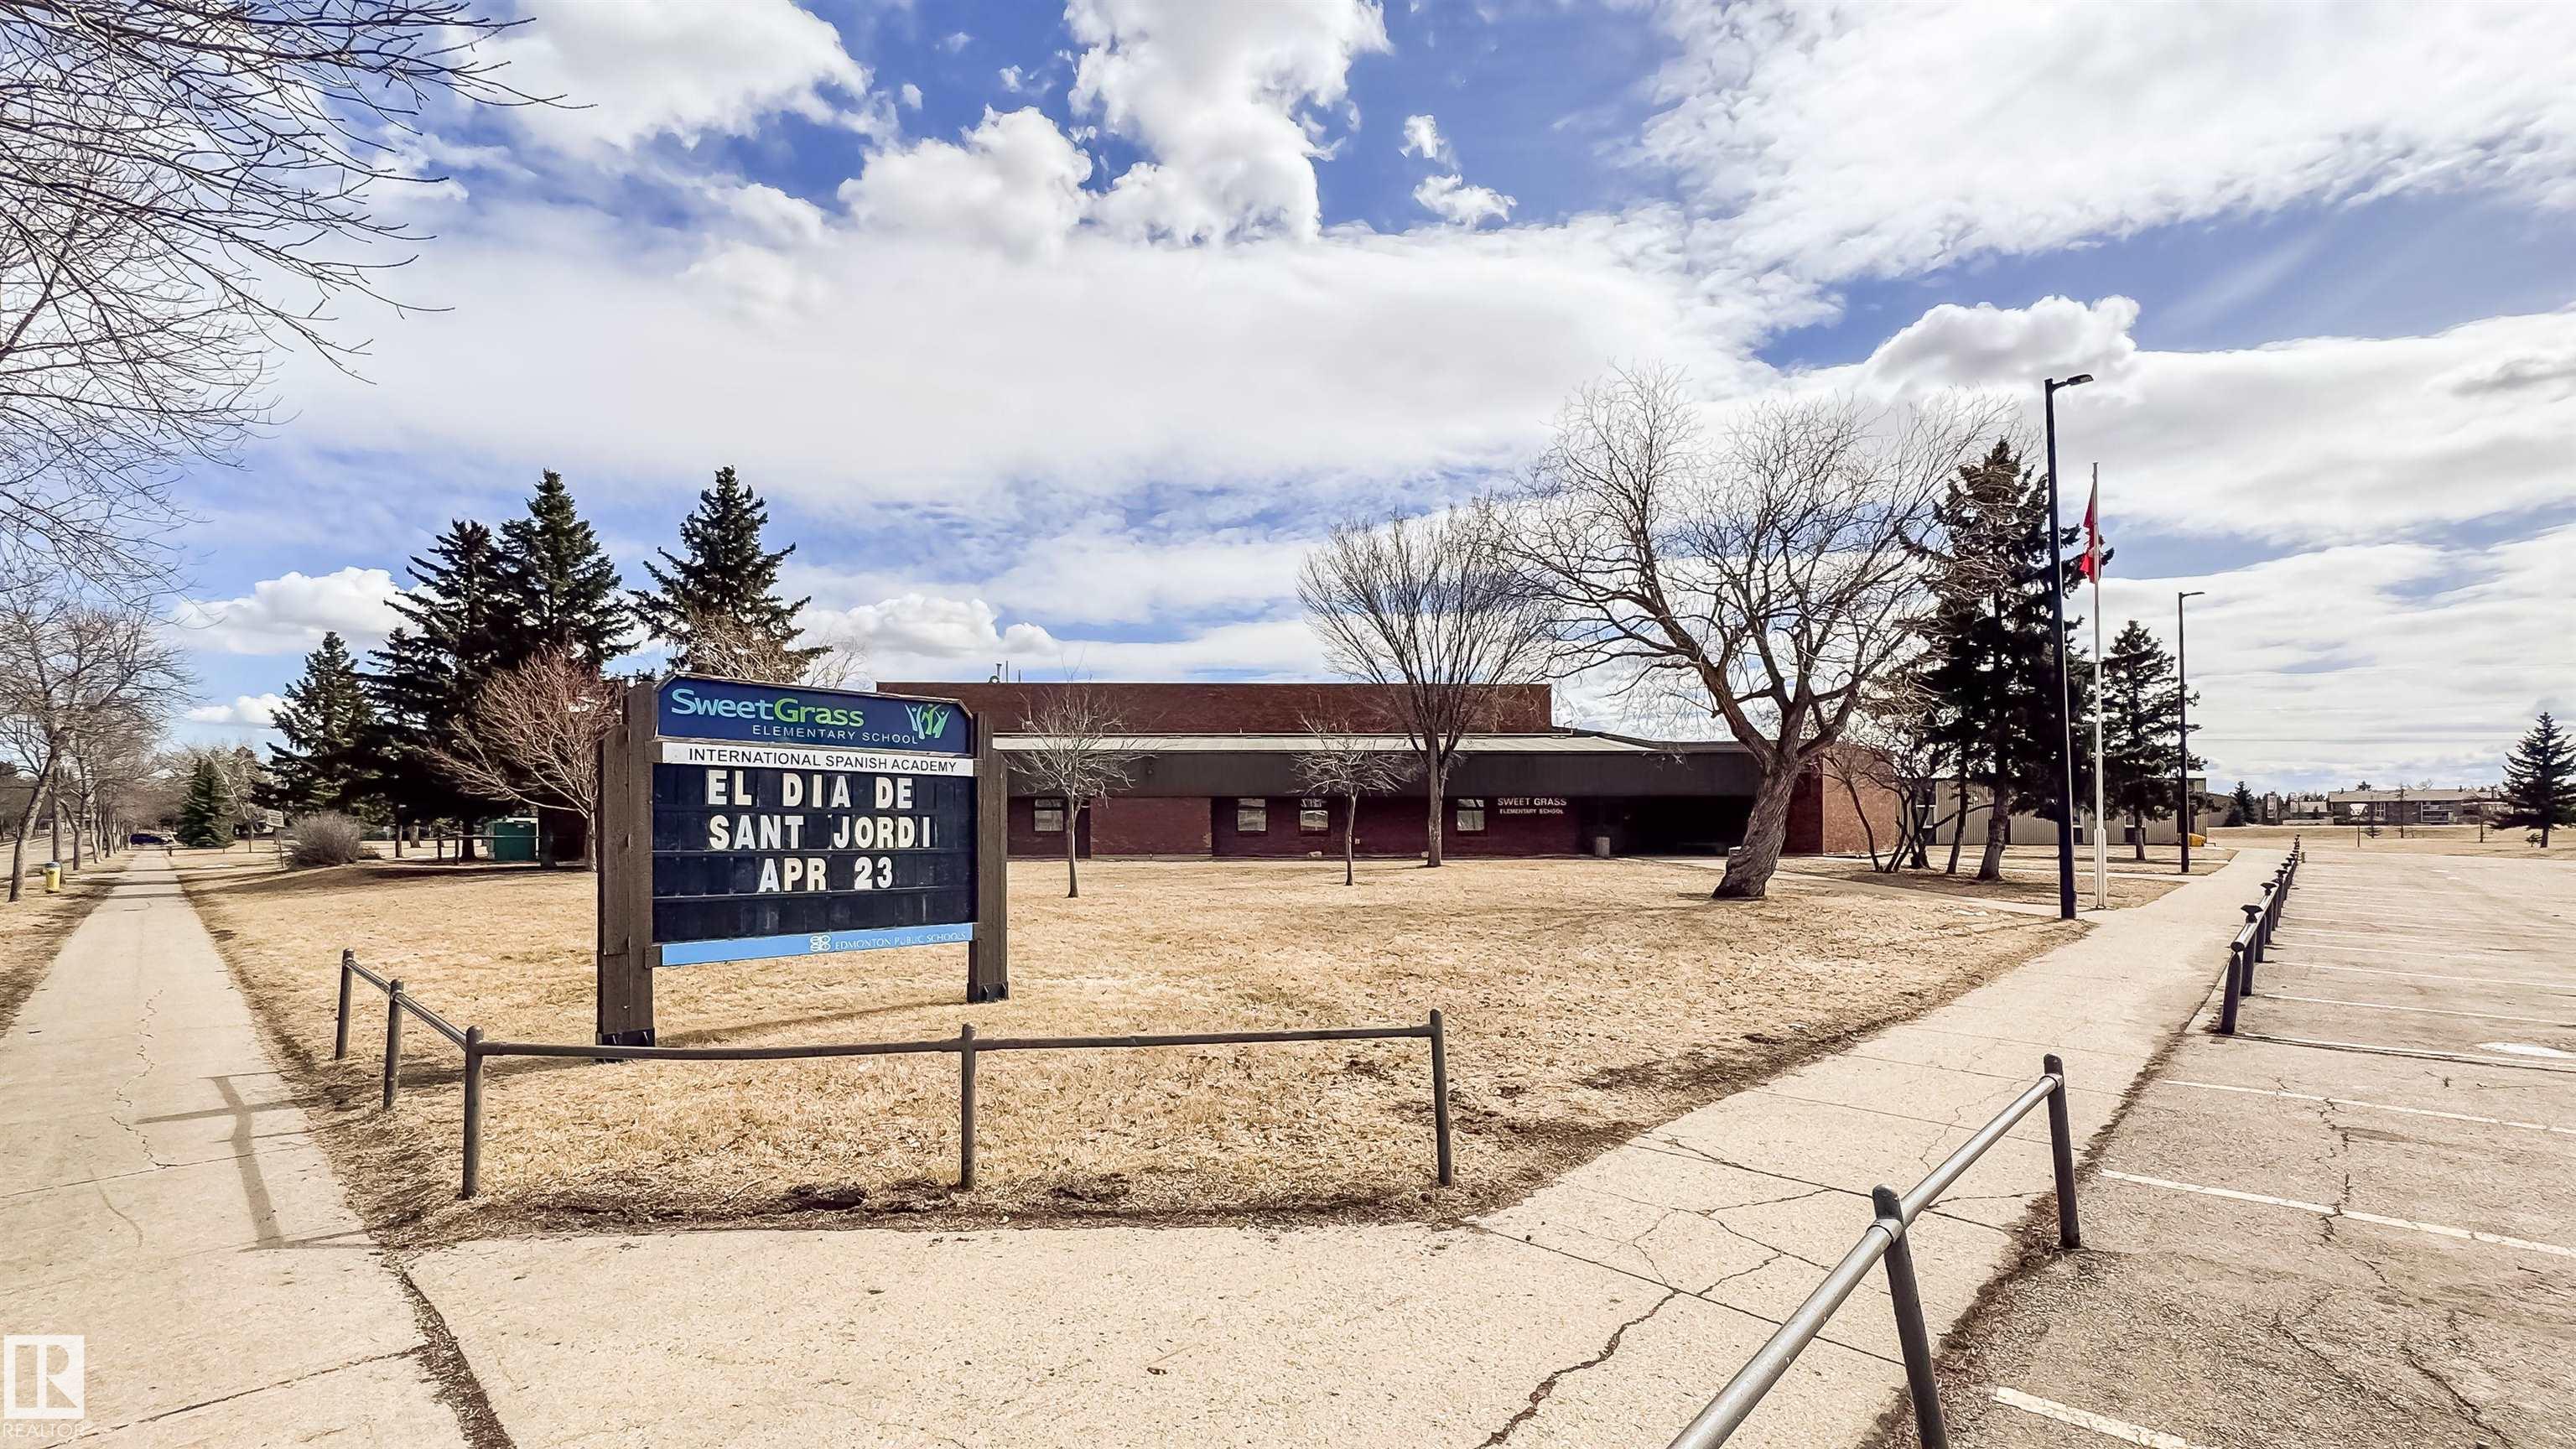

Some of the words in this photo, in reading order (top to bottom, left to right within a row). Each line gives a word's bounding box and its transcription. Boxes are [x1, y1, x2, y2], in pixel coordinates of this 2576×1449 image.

[753, 724, 855, 741] ELEMENTARY
[862, 732, 918, 745] SCHOOL
[688, 748, 821, 767] INTERNATIONAL
[825, 755, 887, 770] SPANISH
[891, 759, 957, 772] ACADEMY
[707, 769, 752, 806] EL
[782, 772, 851, 808] DIA
[875, 776, 913, 809] DE
[1497, 797, 1531, 806] SWEET
[1534, 797, 1567, 806] GRASS
[709, 814, 804, 850] SANT
[833, 816, 931, 849] JORDI
[758, 858, 827, 893] APR
[854, 856, 893, 891] 23
[834, 937, 892, 951] EDMONTON
